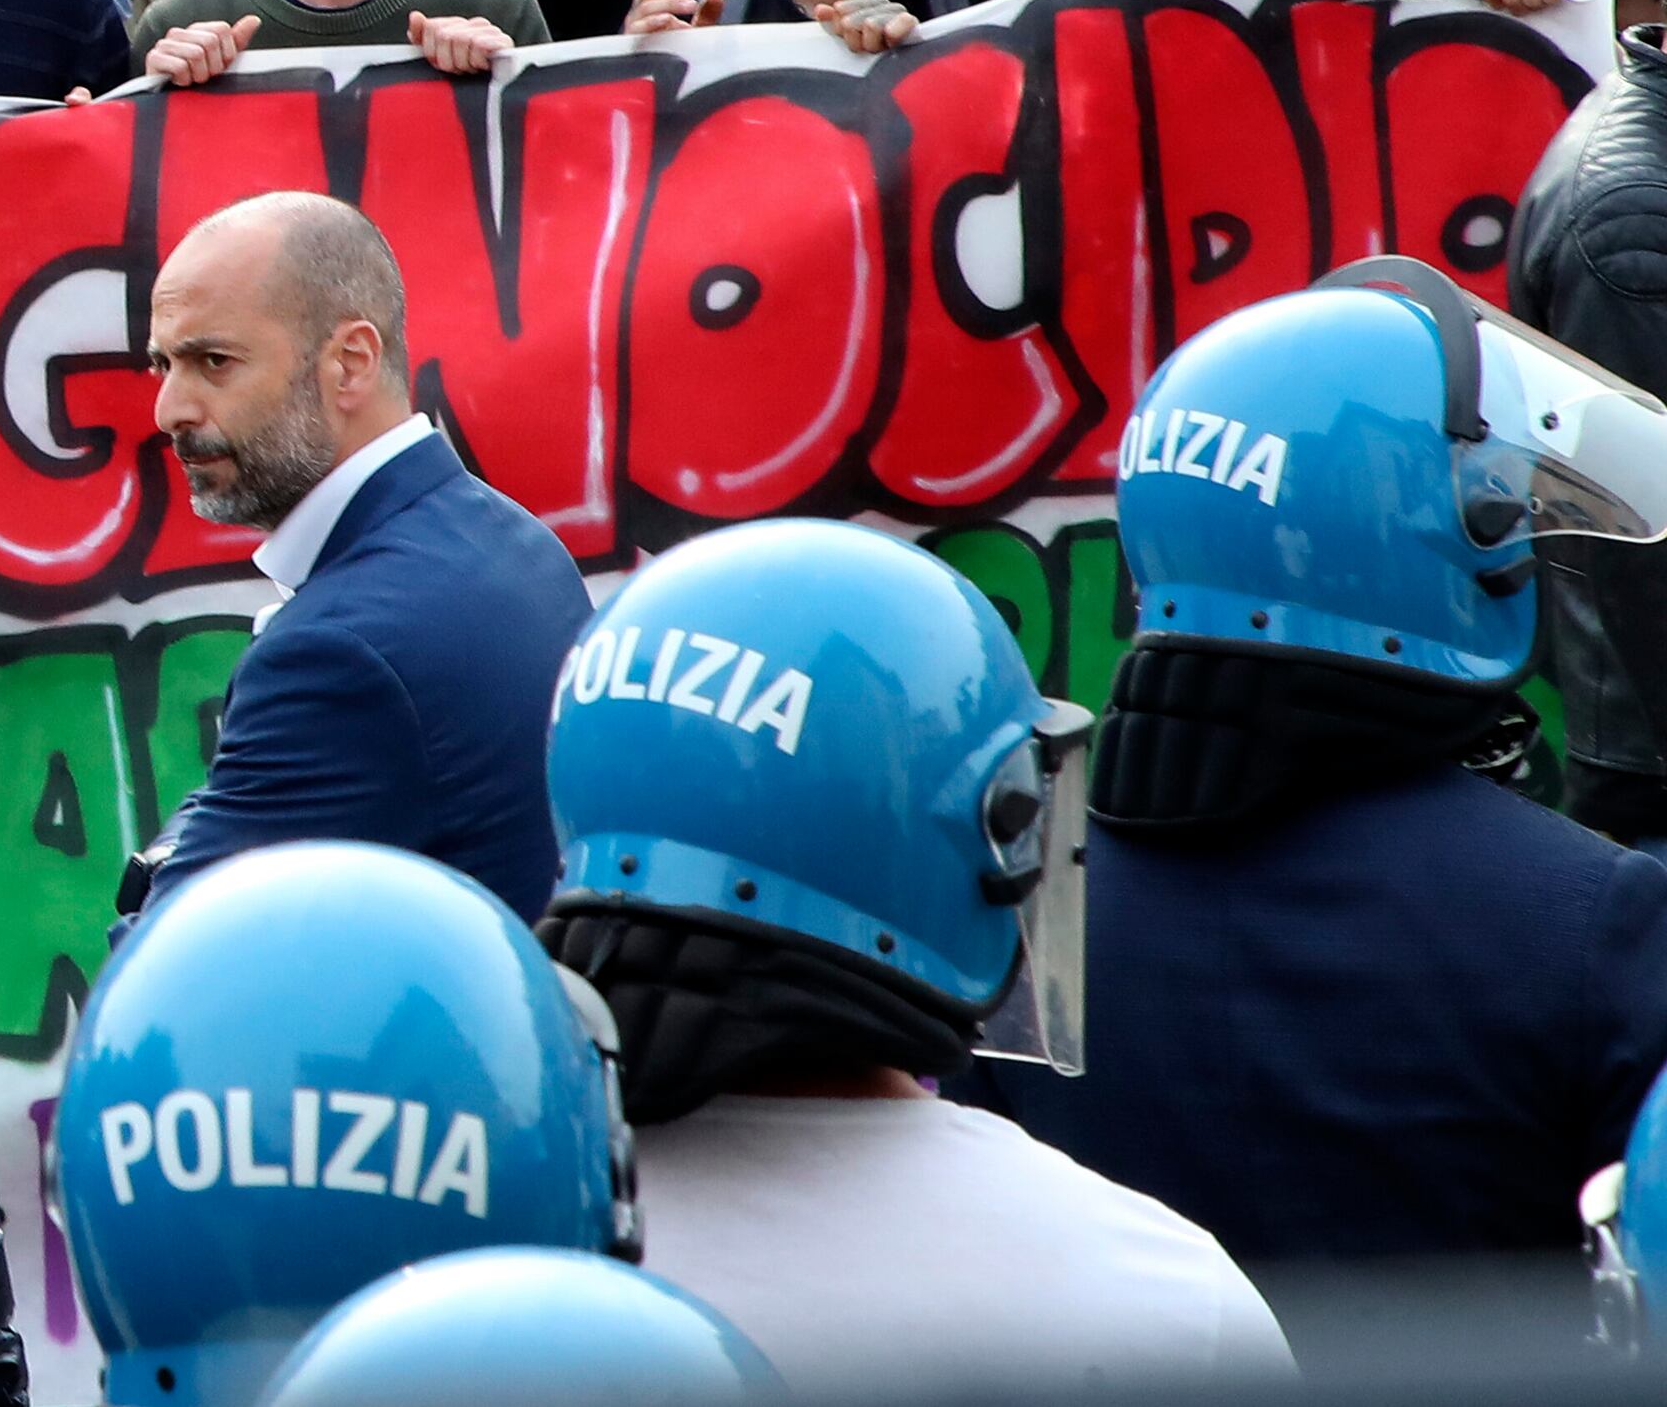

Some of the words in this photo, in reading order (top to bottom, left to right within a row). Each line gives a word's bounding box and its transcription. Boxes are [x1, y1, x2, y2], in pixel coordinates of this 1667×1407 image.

[1118, 407, 1288, 508] OLIZIA
[551, 625, 814, 757] POLIZIA
[101, 1087, 490, 1220] POLIZIA
